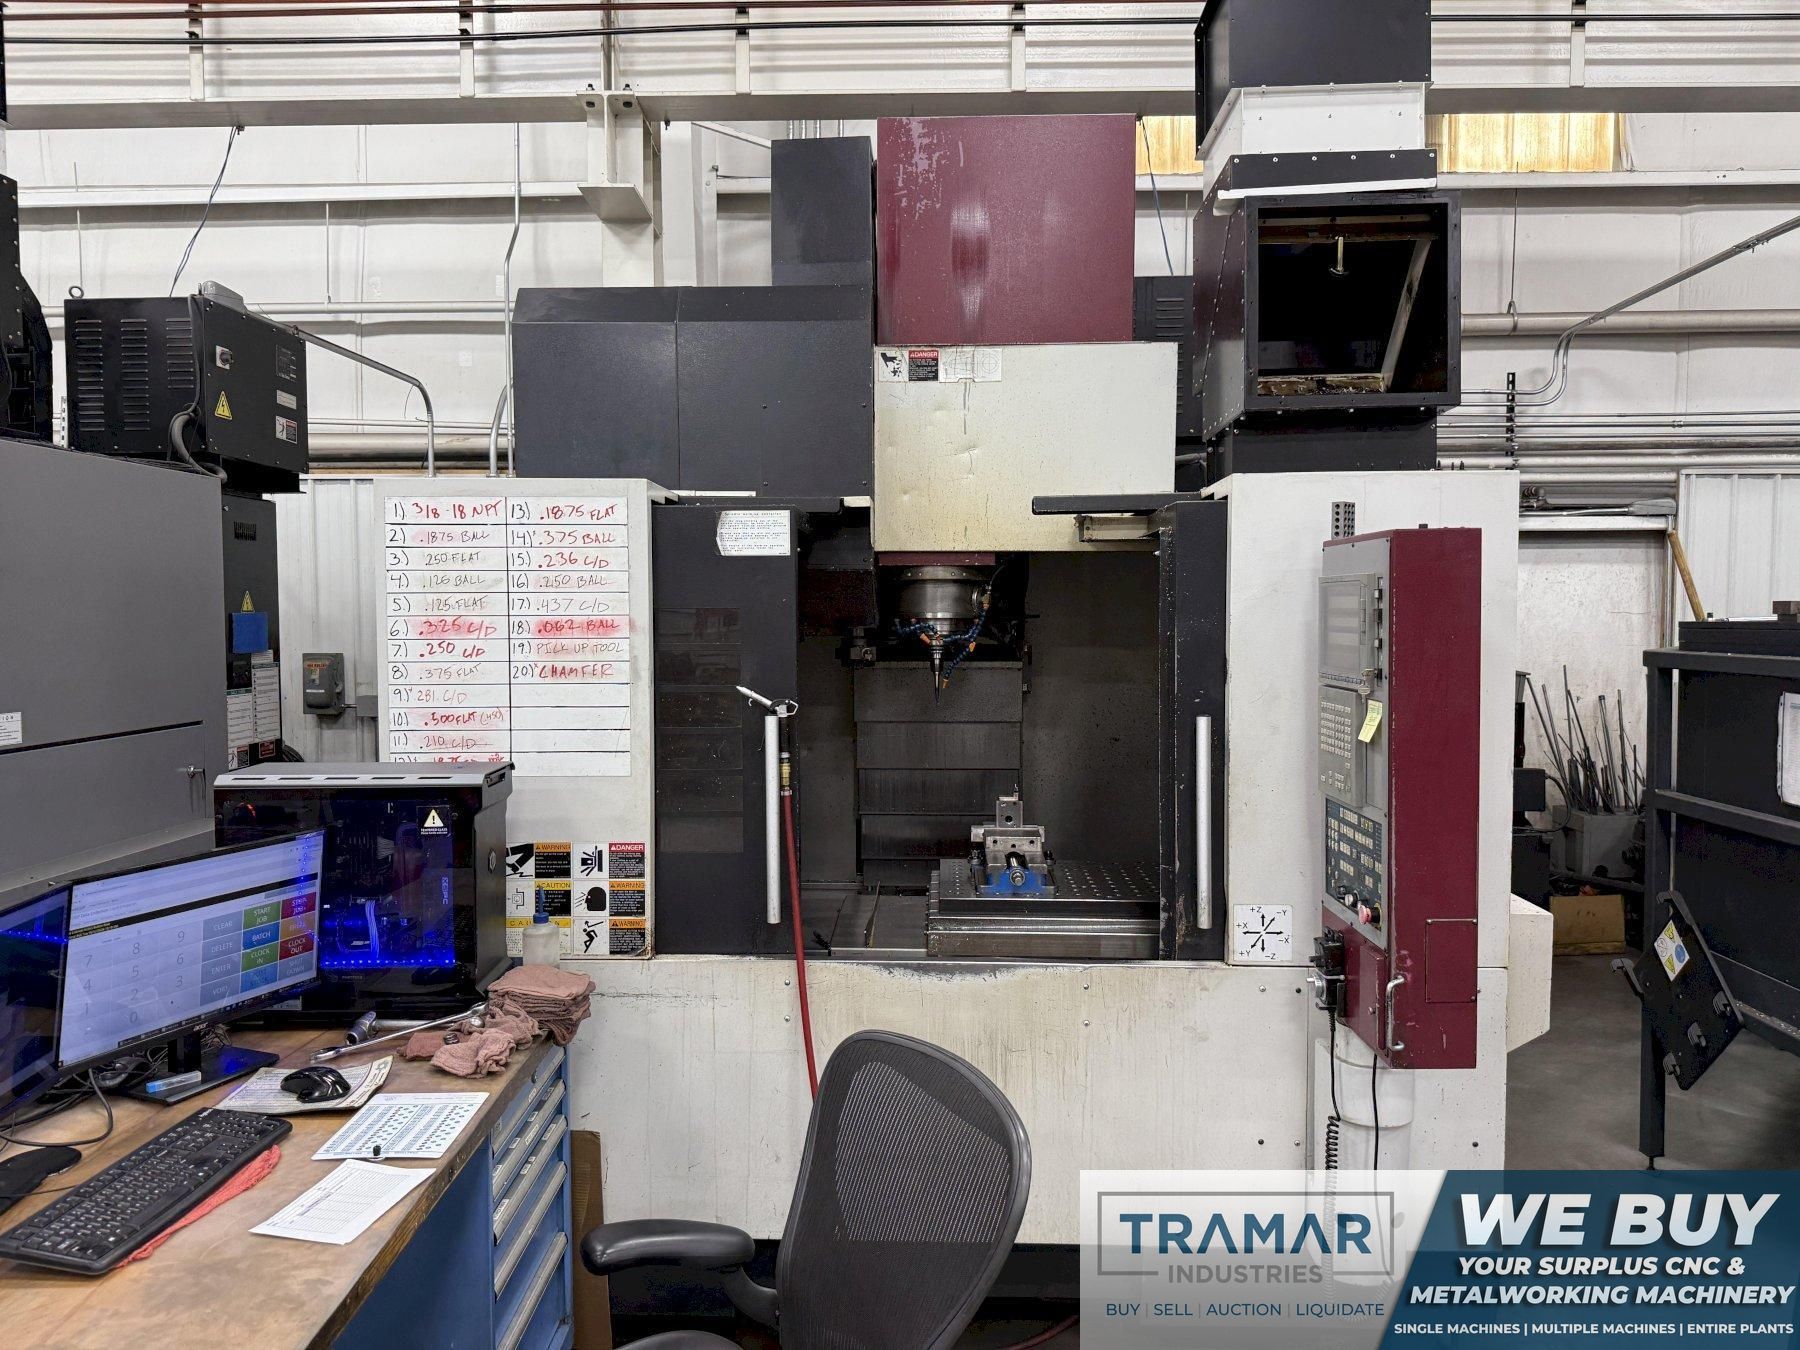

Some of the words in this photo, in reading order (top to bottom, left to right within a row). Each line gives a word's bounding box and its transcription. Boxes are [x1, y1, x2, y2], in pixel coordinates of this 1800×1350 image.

[472, 500, 502, 518] NPT
[540, 505, 584, 520] .1875
[590, 504, 617, 521] FLAT
[420, 532, 453, 544] .1875
[460, 530, 490, 543] BALL
[539, 530, 578, 545] .375
[582, 533, 616, 544] BALL
[425, 554, 448, 566] .250
[451, 551, 481, 562] FLAT
[538, 552, 578, 569] .236
[584, 555, 609, 569] C/D
[454, 574, 486, 587] BALL
[540, 575, 571, 588] .250
[577, 574, 608, 588] BALL
[425, 596, 453, 611] .125
[455, 595, 489, 611] FLAT
[537, 598, 574, 613] .437
[580, 598, 609, 613] C/D
[467, 620, 497, 639] C/D
[586, 619, 620, 632] BALL
[420, 640, 455, 658] .250
[537, 643, 569, 655] PICK
[574, 643, 589, 654] UP
[593, 643, 624, 654] TOOL
[420, 666, 452, 680] .375
[456, 663, 482, 677] FLAT
[539, 663, 614, 679] CHAMFER
[442, 689, 468, 704] C/D
[424, 712, 455, 726] .500
[455, 711, 478, 726] FLAT
[254, 906, 272, 917] START
[214, 921, 233, 931] CLEAR
[256, 915, 269, 925] JOB
[178, 930, 184, 942] 9
[252, 931, 271, 942] BATCH
[288, 937, 306, 948] CLOCK
[132, 942, 140, 954] 8
[211, 942, 233, 953] DELETE
[251, 948, 270, 959] CLOCK
[290, 946, 302, 954] OUT
[84, 954, 93, 967] 7
[177, 953, 184, 965] 6
[132, 965, 139, 978] 5
[83, 979, 92, 991] 4
[176, 975, 183, 988] 3
[131, 989, 138, 1001] 2
[85, 1002, 89, 1016] 1
[130, 1011, 138, 1024] 0
